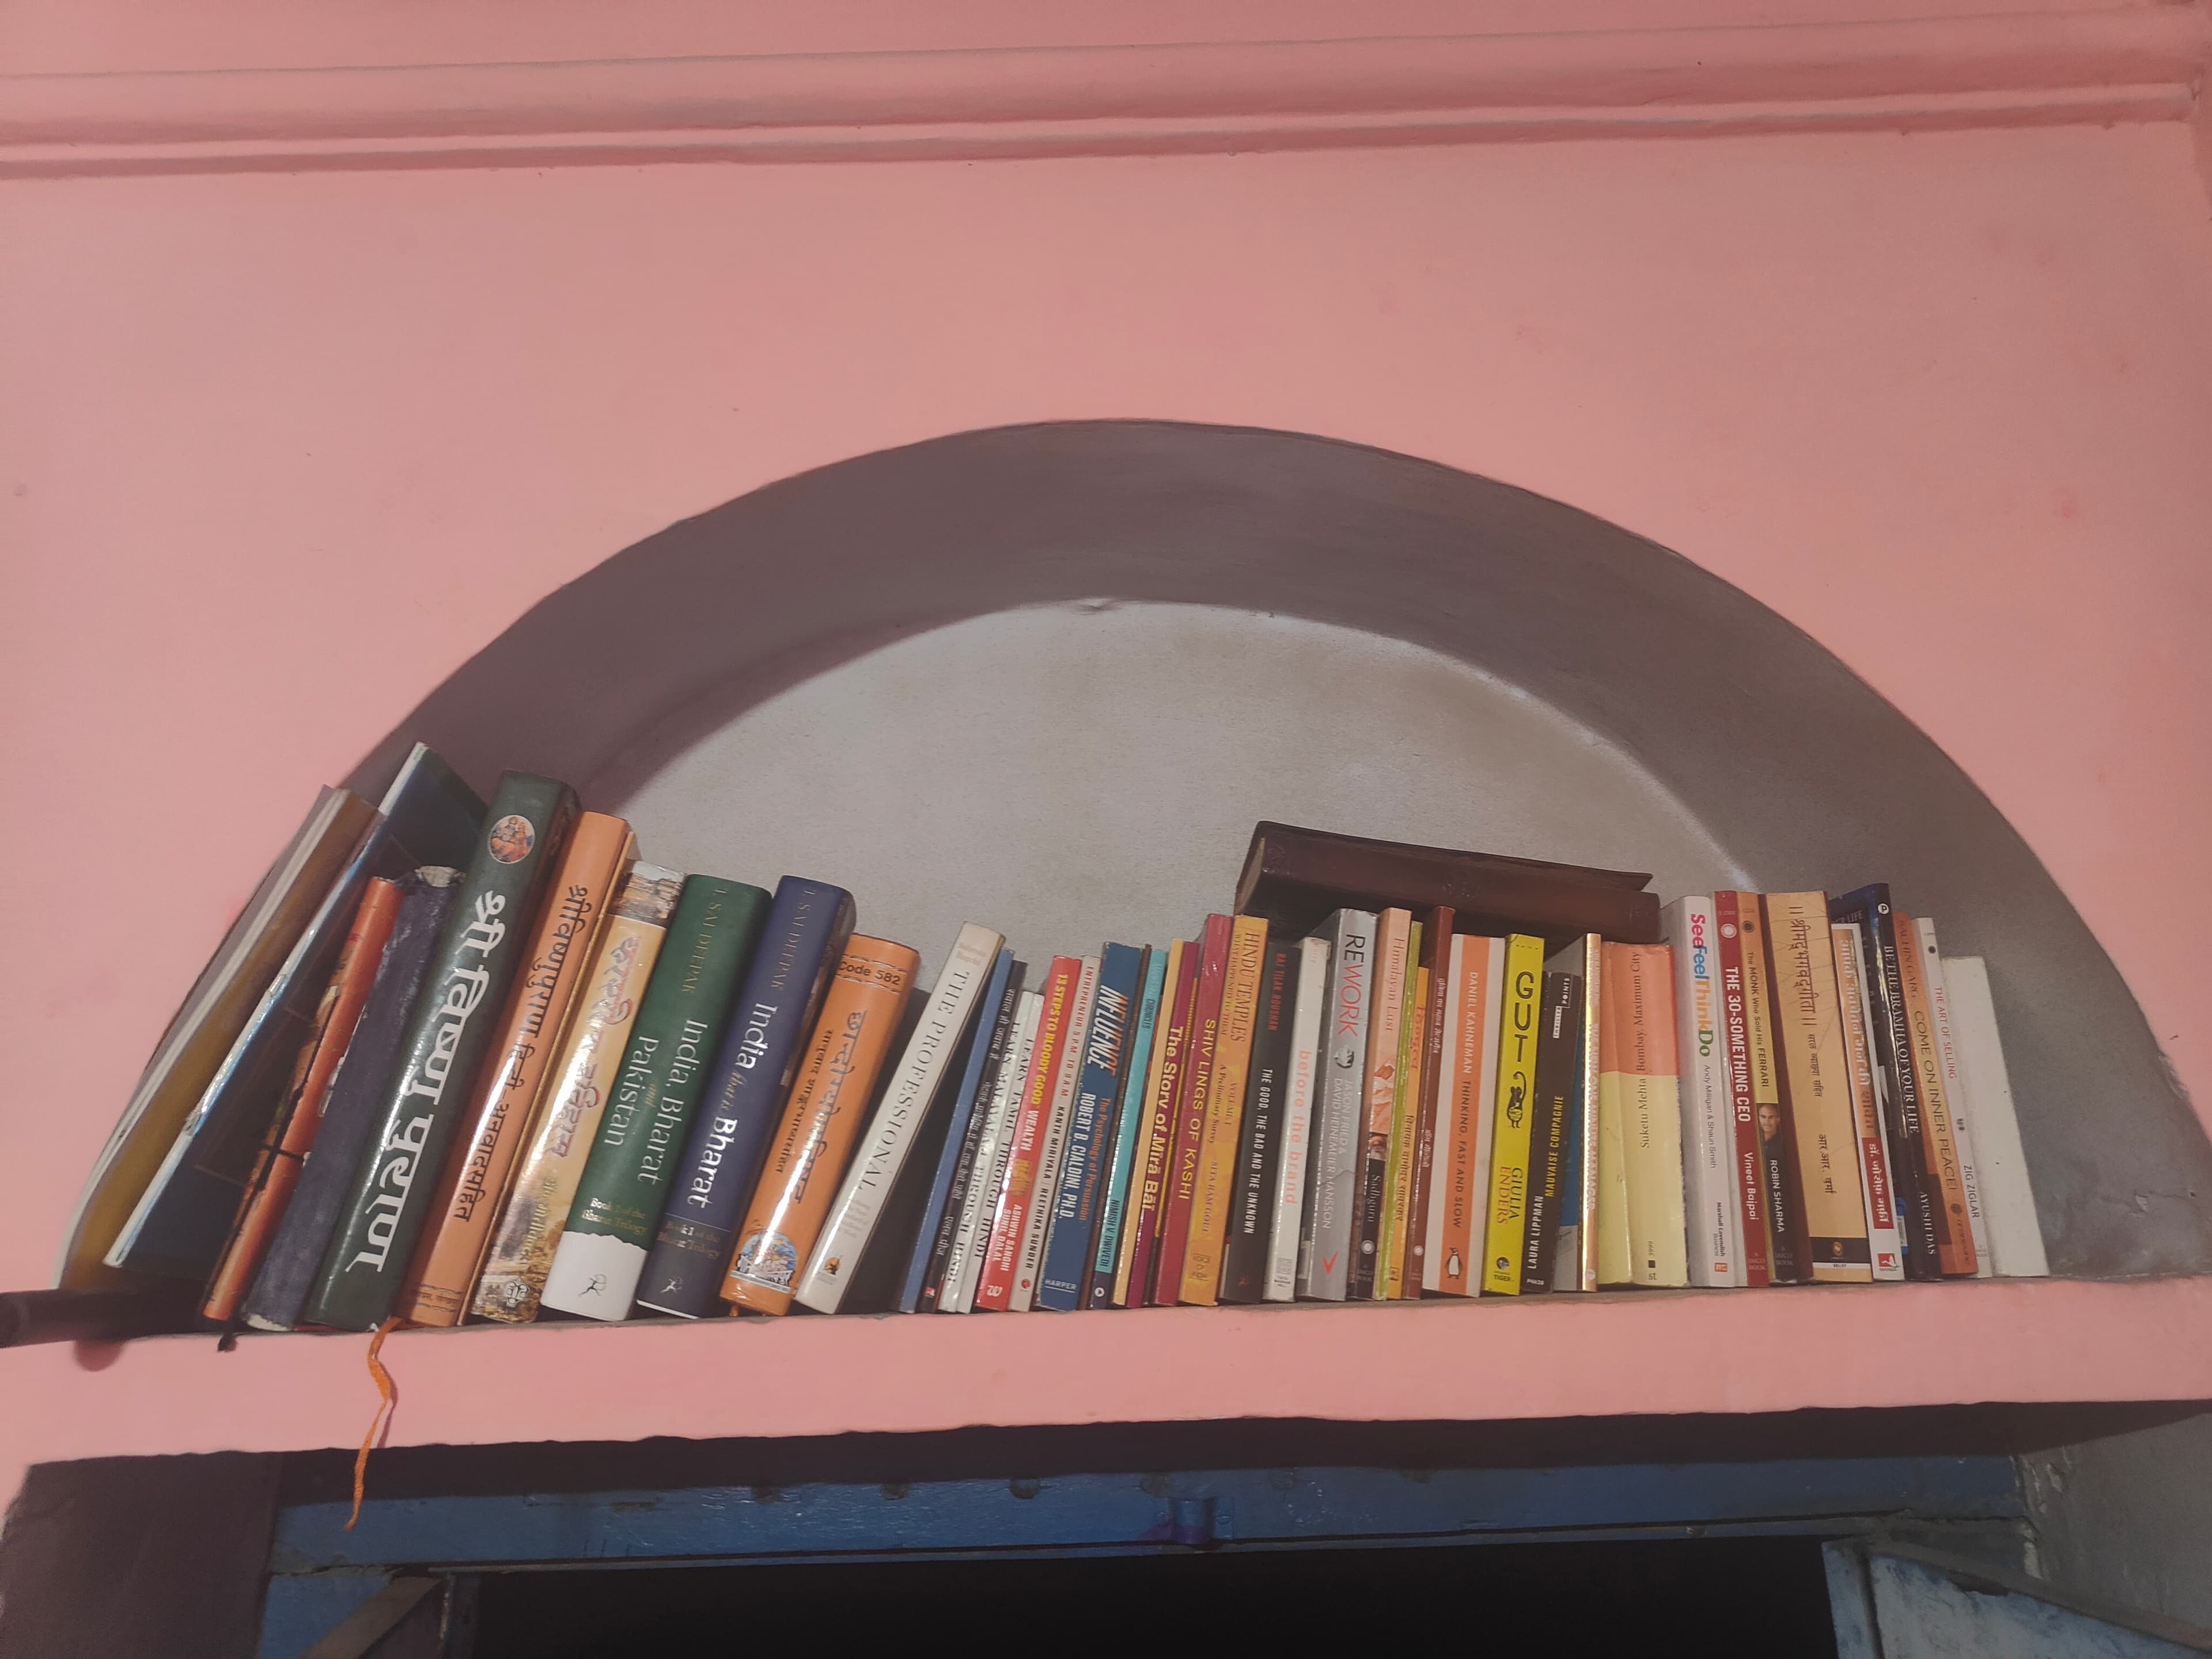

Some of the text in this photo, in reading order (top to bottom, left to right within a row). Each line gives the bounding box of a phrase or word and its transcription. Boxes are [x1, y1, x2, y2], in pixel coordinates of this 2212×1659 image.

[518, 885, 588, 1038] श्रीविष्णुपुराण
[839, 959, 902, 986] Code 582
[1219, 932, 1242, 1036] WHAT HAPPENED TO THEM
[1383, 937, 1404, 1032] Himalayan Lust
[1630, 950, 1643, 972] City
[1883, 945, 1895, 962] BE
[1885, 961, 1900, 991] THE
[1049, 985, 1066, 1016] STEPS
[1229, 931, 1260, 1043] HINDU TEMPLES
[1336, 933, 1366, 1037] REWORK
[1562, 976, 1570, 1004] POINTS
[1632, 974, 1643, 1026] Maximum
[1002, 1021, 1021, 1065] LEARN
[1046, 1016, 1058, 1031] TO
[1087, 984, 1128, 1076] INFLUENCE
[1165, 1024, 1183, 1058] The
[1461, 971, 1479, 1074] DANIEL KAHNEMAN
[1513, 971, 1534, 1063] GUT
[1724, 966, 1751, 1123] THE 30-SOMETHING CEO
[1747, 951, 1769, 1088] The MONK Who Sold His FERRARI
[1912, 1009, 1932, 1055] COME
[1934, 986, 1957, 1080] THE ART OF SELLING
[346, 890, 505, 1272] श्री विष्णु पुराण
[859, 970, 969, 1190] THE PROFESSIONAL
[1036, 1032, 1055, 1074] BLOODY
[1897, 1047, 1910, 1067] OF
[1922, 1059, 1938, 1086] ON
[605, 1036, 659, 1146] Pakistan
[688, 1002, 778, 1209] India that is Bharat
[978, 1071, 1009, 1157] MALAYALAM
[1030, 1074, 1046, 1105] GOOD
[1177, 1018, 1217, 1200] SHIV LINGS OF KASHI
[1210, 1071, 1226, 1117] Preliminary
[1637, 1077, 1650, 1148] Suketu Mehta
[1900, 1066, 1915, 1103] YOUR
[1927, 1087, 1946, 1133] INNER
[638, 1096, 685, 1185] Bharat
[973, 1038, 1034, 1259] LEARN TAMIL THROUGH HINDI
[1019, 1108, 1039, 1152] WEALTH
[1153, 1113, 1170, 1132] of
[1206, 1118, 1220, 1145] Survey
[1283, 1050, 1312, 1206] before the brand
[1545, 1095, 1564, 1197] MAUVAISE COMPAGNIE
[1905, 1104, 1919, 1134] LIFE
[1058, 1092, 1097, 1221] ROBERT B. CIALDINI, PH.D.
[1078, 1097, 1111, 1221] The Psychology of Persuasion
[1242, 1067, 1273, 1234] THE GOOD, THE BAD AND THE UNKNOWN
[1320, 1077, 1343, 1229] DAVID HEINEMEIER HANSSON
[1450, 1080, 1471, 1229] THINKING, FAST AND SLOW
[959, 1165, 984, 1233] THROUGH
[1025, 1105, 1065, 1270] KANTH MIRIYALA REETHIKA SUNDER
[1106, 1198, 1120, 1226] NIMISH
[1364, 1173, 1381, 1224] Sadhguru
[1495, 1165, 1513, 1225] ENDERS
[1508, 1166, 1524, 1220] GIULIA
[1715, 1201, 1724, 1227] Marshall
[1743, 1151, 1758, 1221] Vineet Bajpai
[1768, 1159, 1785, 1233] ROBIN SHARMA
[1963, 1164, 1979, 1219] ZIG ZIGLAR
[991, 1208, 1012, 1263] SUNIL DALAL
[999, 1203, 1022, 1272] ASHWIN SANGHI
[1099, 1234, 1113, 1267] DWIVEDI
[1527, 1194, 1544, 1269] LAURA LIPPMAN
[1717, 1227, 1726, 1257] Cavendish
[1919, 1190, 1936, 1255] AYUSHI DAS
[945, 1241, 965, 1284] HINDI
[1045, 1278, 1077, 1290] HARPER
[1648, 1271, 1658, 1281] st
